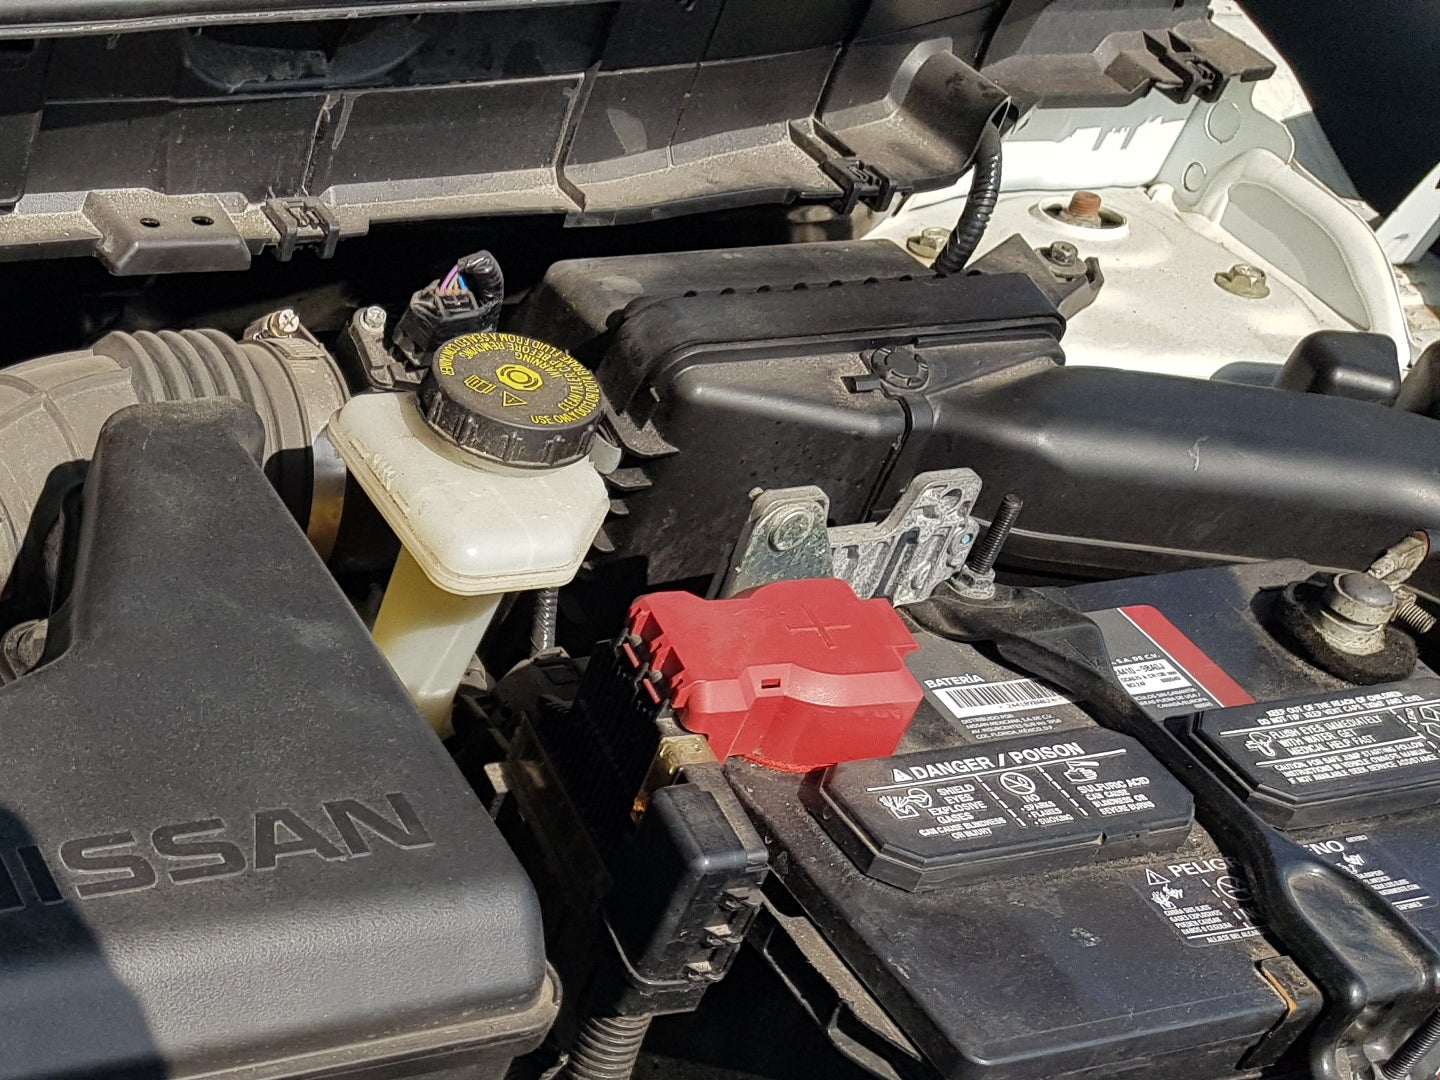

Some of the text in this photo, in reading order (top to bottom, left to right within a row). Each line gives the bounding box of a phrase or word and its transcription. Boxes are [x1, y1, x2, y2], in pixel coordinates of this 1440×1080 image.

[488, 332, 498, 340] A
[499, 333, 530, 346] FROM
[531, 340, 563, 357] FLUID
[514, 351, 562, 379] WARNING
[530, 414, 554, 424] USE
[924, 672, 985, 689] BATERÍA
[1266, 708, 1285, 717] KEEP
[1286, 705, 1303, 714] OUT
[1314, 701, 1332, 709] THE
[1269, 715, 1287, 724] NOT
[1302, 710, 1321, 718] KEEP
[1322, 707, 1343, 715] VENT
[1268, 715, 1382, 739] FLUSH EYES IMMEDIATELY
[1277, 737, 1304, 747] WITH
[1336, 728, 1357, 738] GET
[1285, 743, 1330, 755] MEDICAL
[1326, 738, 1351, 750] HELP
[1306, 759, 1324, 767] FOR
[1394, 741, 1424, 751] FOLLOW
[910, 742, 1086, 781] DANGER / POISON
[936, 784, 975, 796] SHIELD
[1077, 777, 1150, 794] SULFURIC ACID
[944, 793, 974, 805] EYES
[1022, 793, 1040, 803] NO
[1085, 789, 1130, 800] CAN CAUSE
[927, 801, 988, 816] EXPLOSIVE
[936, 812, 975, 824] GASES
[918, 817, 1007, 836] CAN CAUSE BLINDNESS
[951, 830, 964, 839] OR
[1303, 840, 1345, 855] NO
[1168, 858, 1228, 877] PELIG
